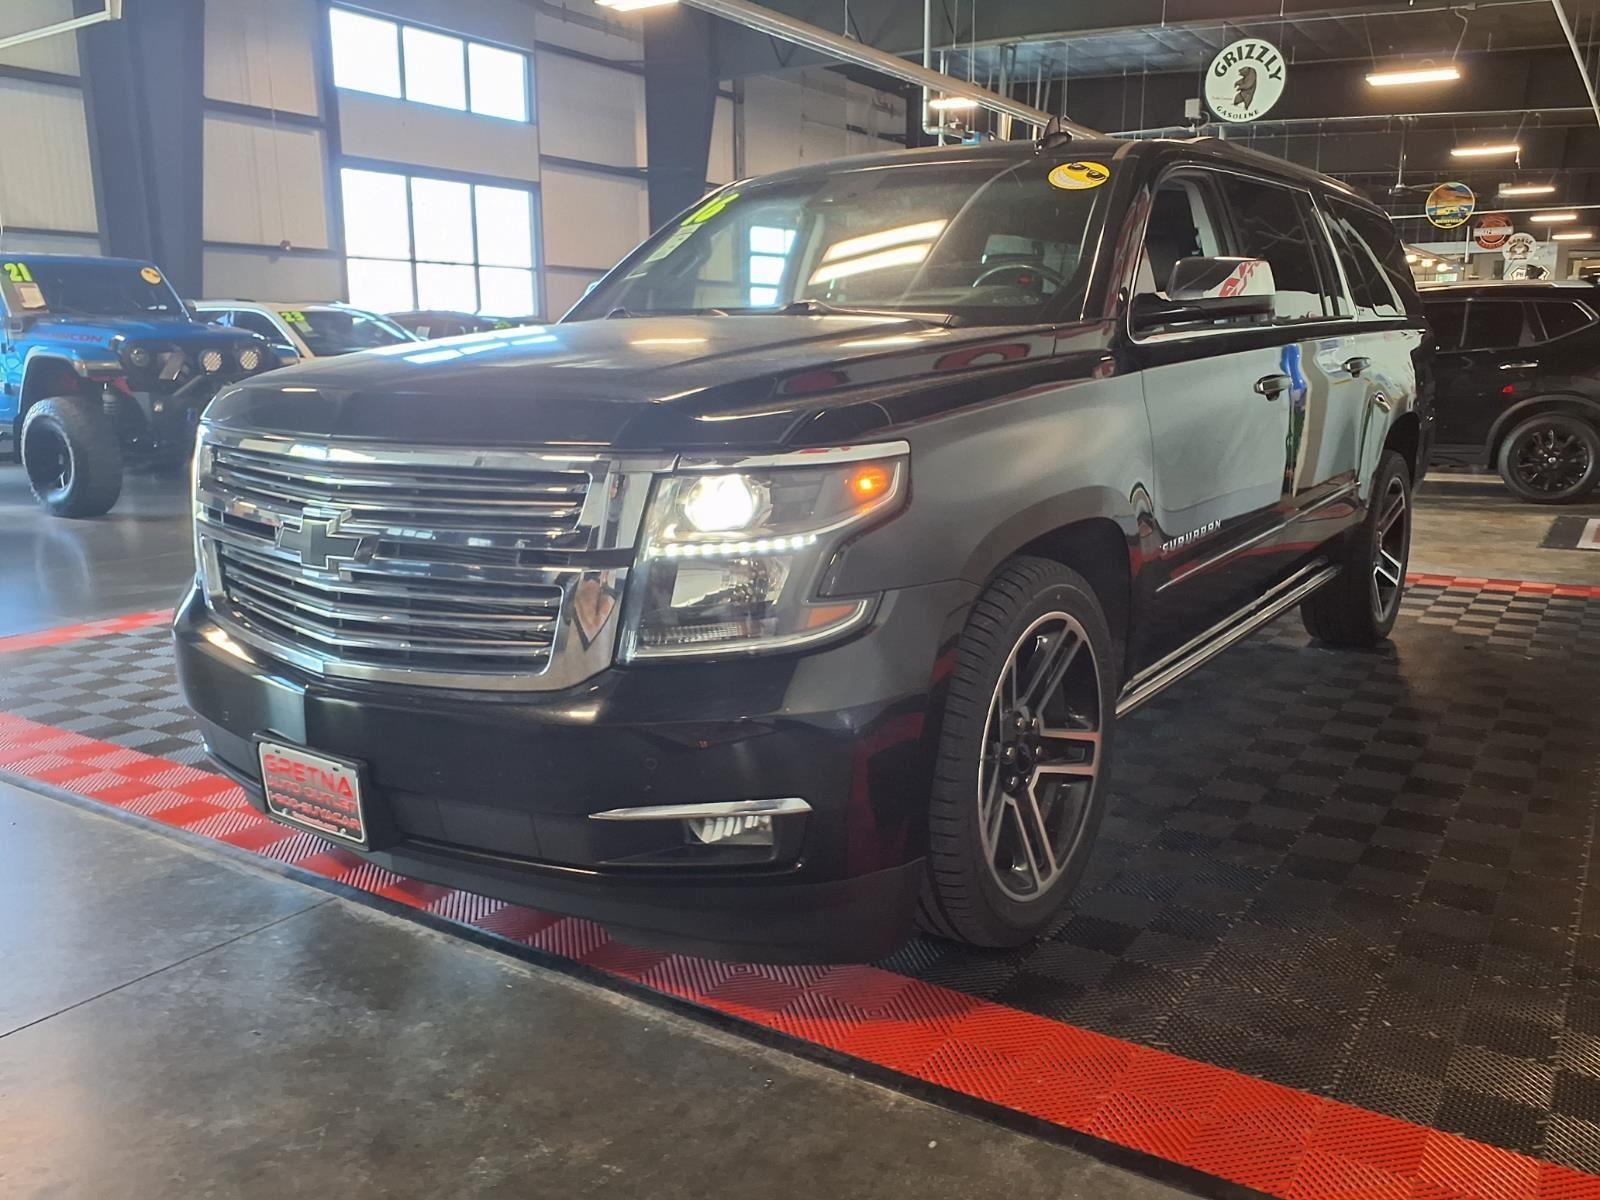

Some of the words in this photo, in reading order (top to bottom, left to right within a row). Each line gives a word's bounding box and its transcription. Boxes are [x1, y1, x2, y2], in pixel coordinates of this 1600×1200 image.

[1214, 43, 1282, 81] GRIZZLY
[1216, 105, 1259, 119] GASOLINE
[4, 262, 33, 282] 21
[280, 310, 305, 323] 23
[1161, 519, 1222, 554] SUBURBAN
[264, 754, 353, 797] GRETNA
